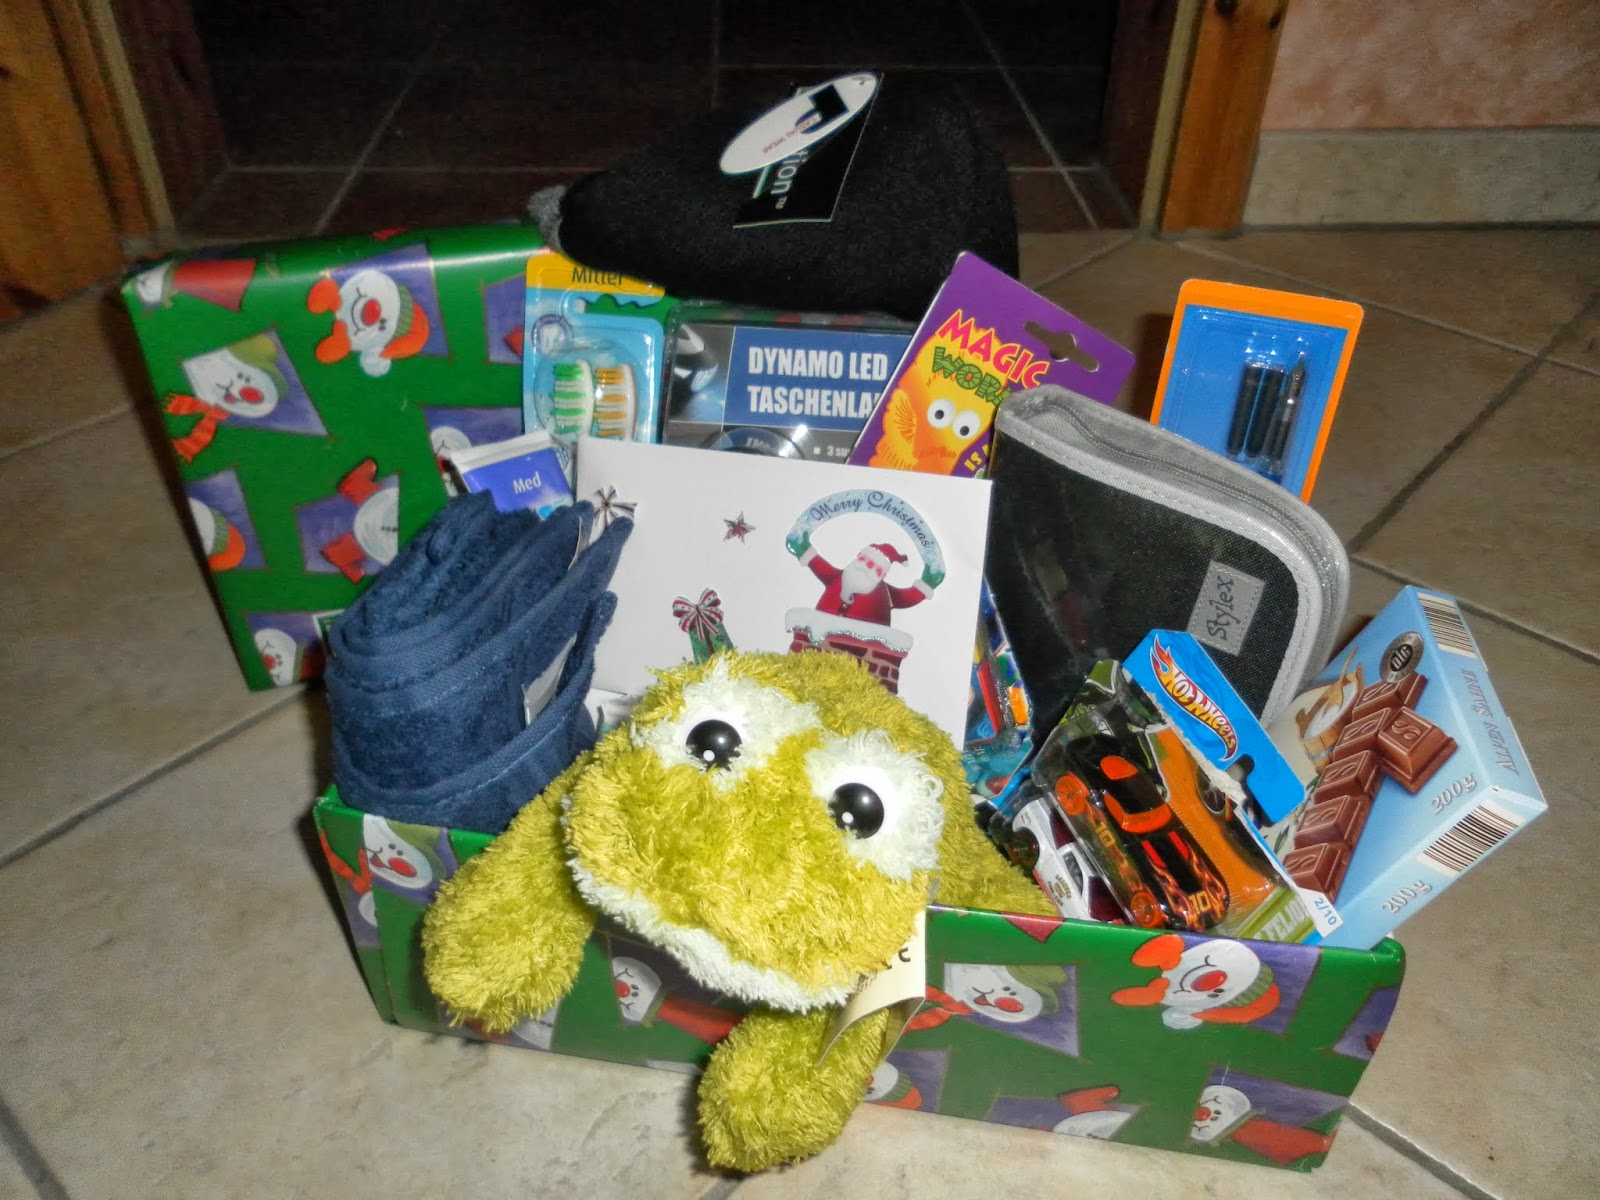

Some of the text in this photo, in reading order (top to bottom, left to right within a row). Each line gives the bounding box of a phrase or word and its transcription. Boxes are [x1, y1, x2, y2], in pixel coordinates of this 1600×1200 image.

[748, 346, 889, 381] DYNAMO LED
[935, 309, 1050, 389] MAGIC
[747, 385, 882, 419] TASCHENLA
[827, 445, 834, 457] 3
[963, 451, 982, 471] IS
[512, 471, 542, 494] Med
[810, 491, 934, 549] Merry Christmas
[1206, 575, 1241, 641] Stylex
[1431, 773, 1477, 814] 200g
[1188, 890, 1212, 914] 10
[1314, 897, 1337, 926] 2/10
[1381, 880, 1432, 914] 200g
